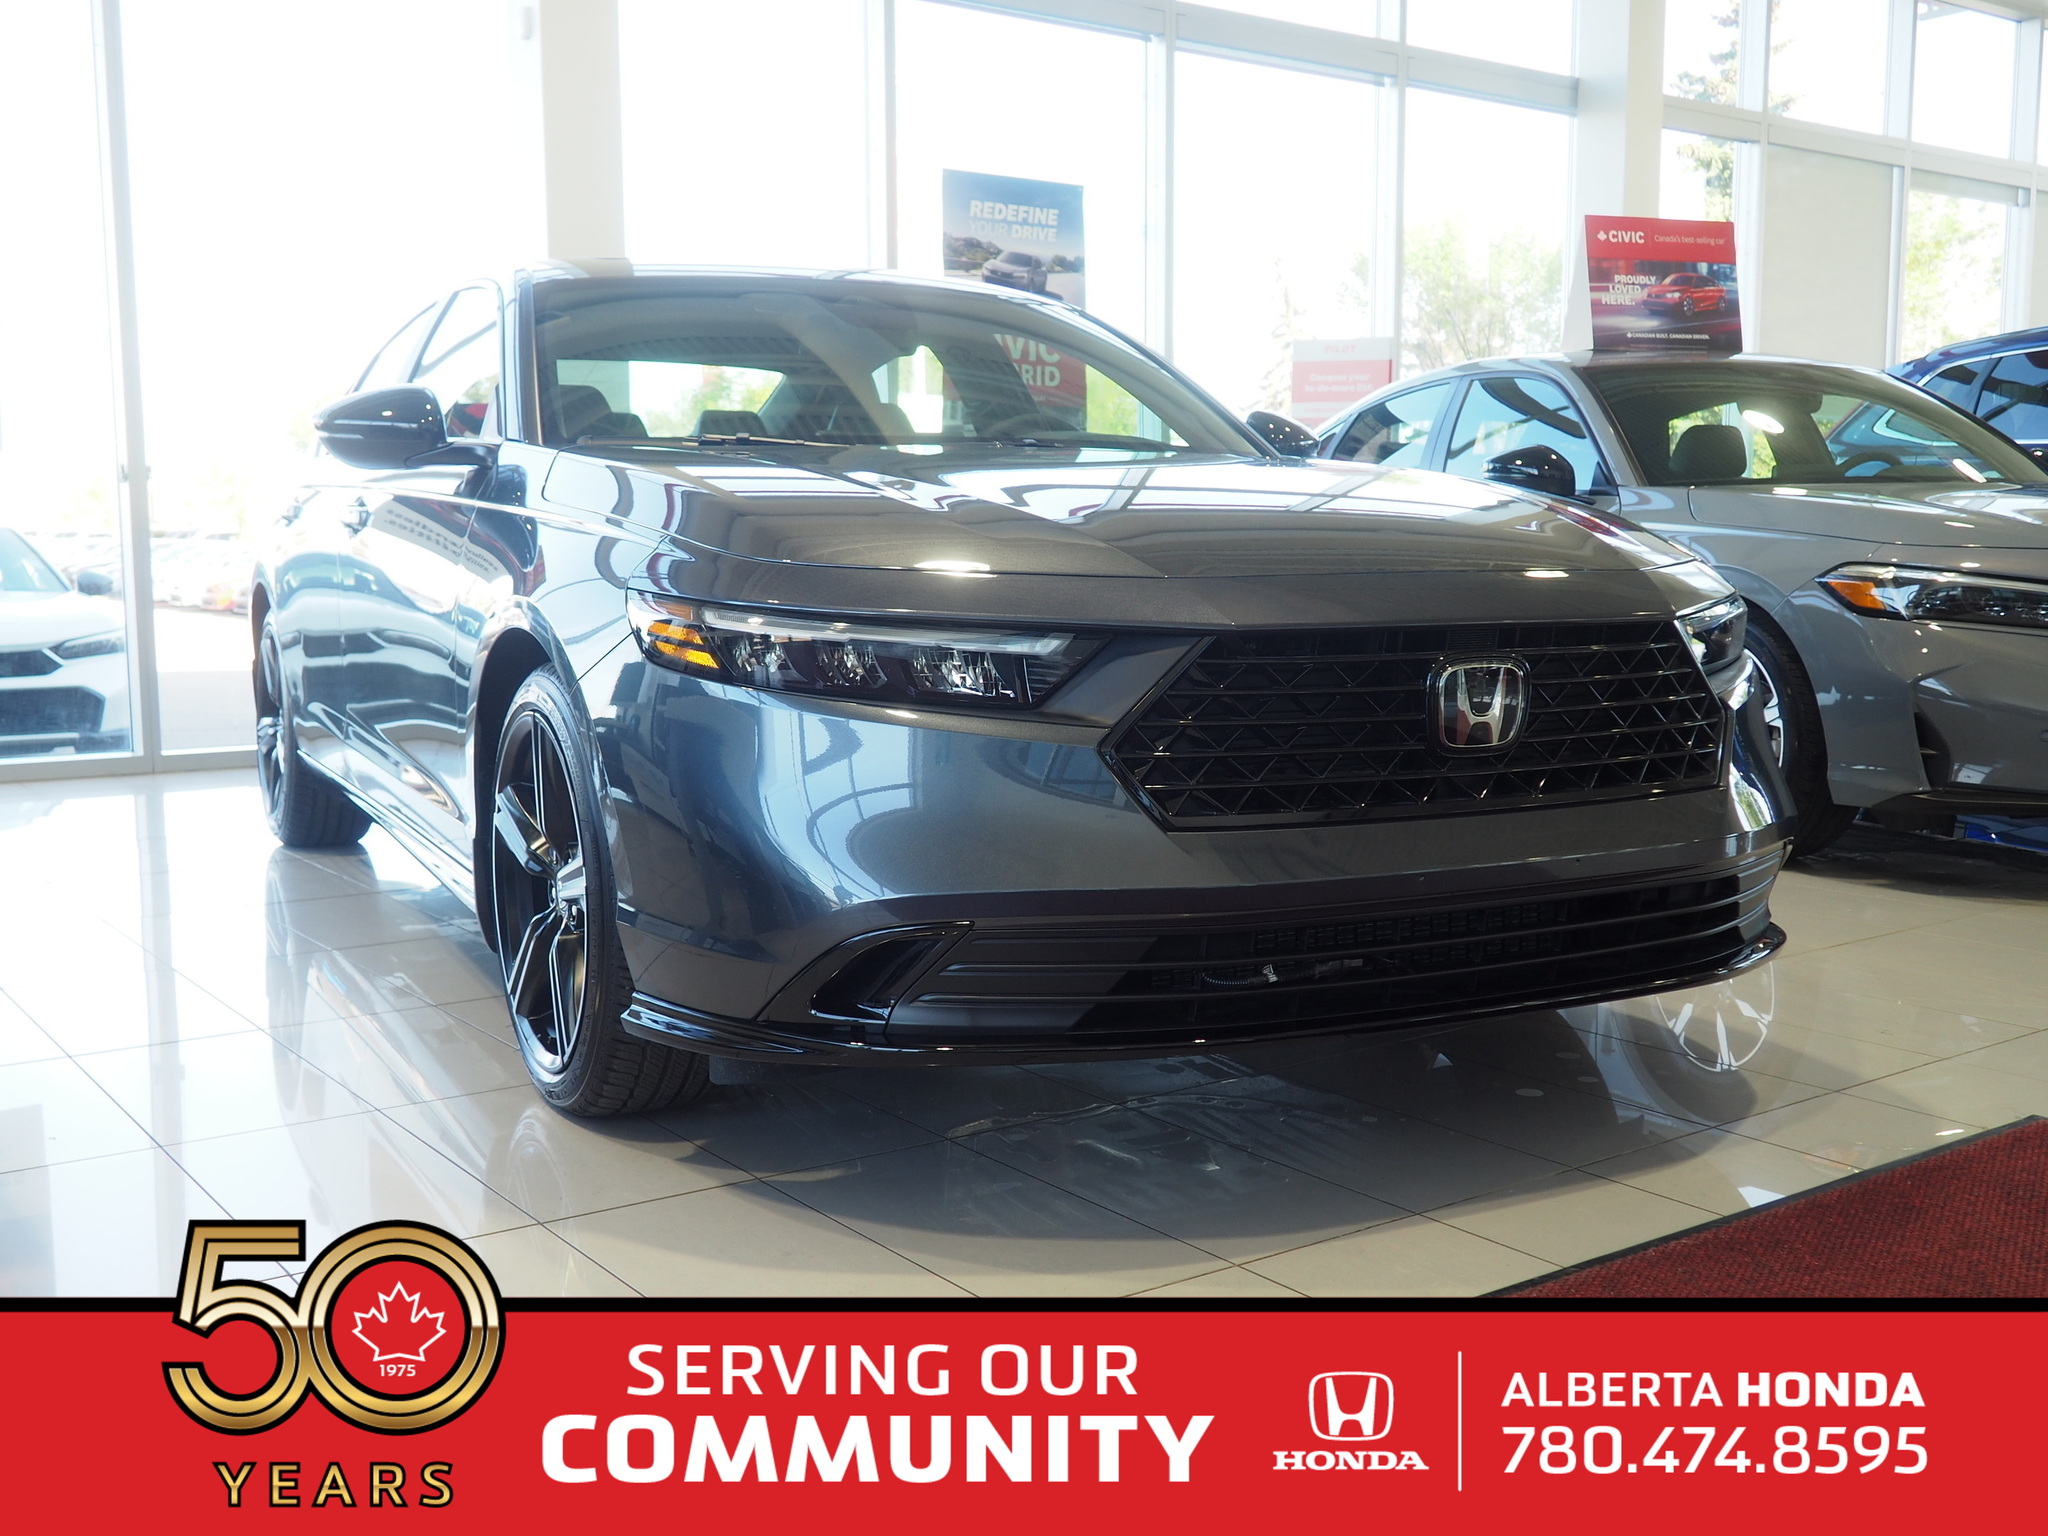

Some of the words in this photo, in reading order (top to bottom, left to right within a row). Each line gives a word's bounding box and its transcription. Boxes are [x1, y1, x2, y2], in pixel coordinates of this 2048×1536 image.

[969, 200, 1059, 226] REDEFINE
[970, 219, 1008, 238] YOUR
[1011, 224, 1058, 242] DRIVE
[1608, 230, 1645, 244] CIVIC
[1654, 234, 1681, 243] Canada's
[1682, 236, 1715, 246] best-selling
[1614, 274, 1656, 285] PROUDLY
[1609, 284, 1642, 294] LOVED
[1602, 294, 1636, 305] HERE.
